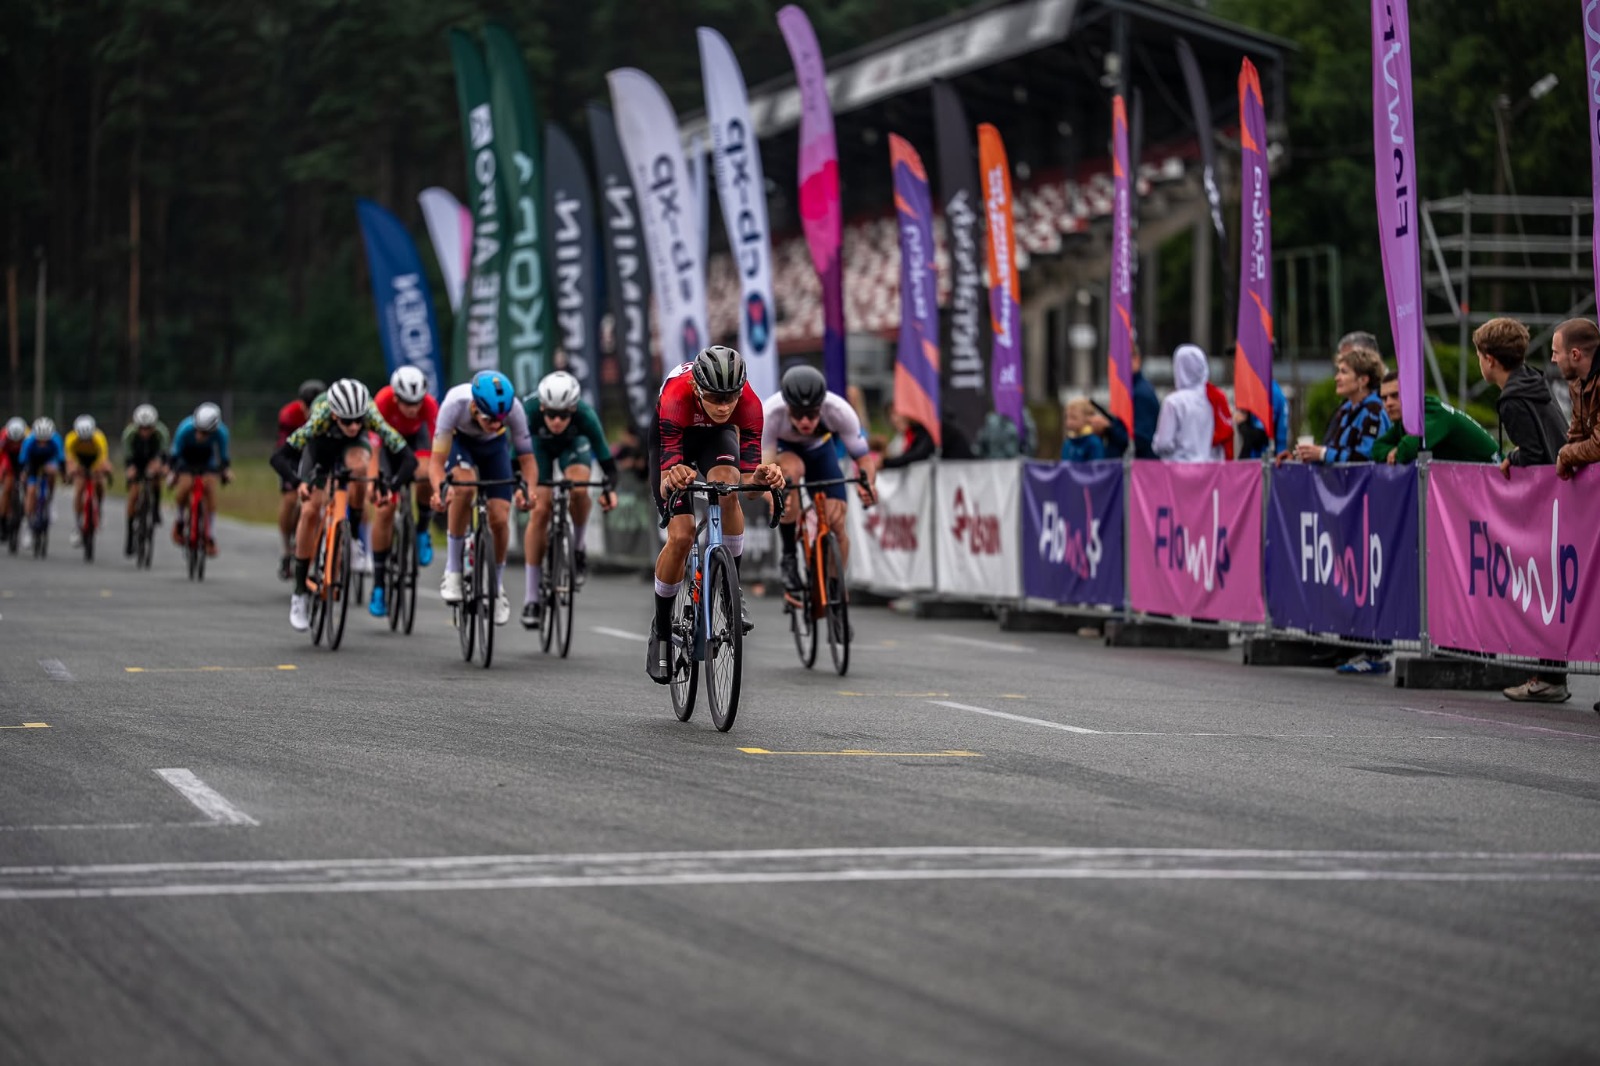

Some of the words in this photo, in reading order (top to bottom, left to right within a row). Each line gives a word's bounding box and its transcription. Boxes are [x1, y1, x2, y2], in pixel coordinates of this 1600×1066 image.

[1155, 489, 1231, 592] FlowUp
[1300, 494, 1383, 608] FlowUp
[1469, 498, 1579, 626] FlowUp
